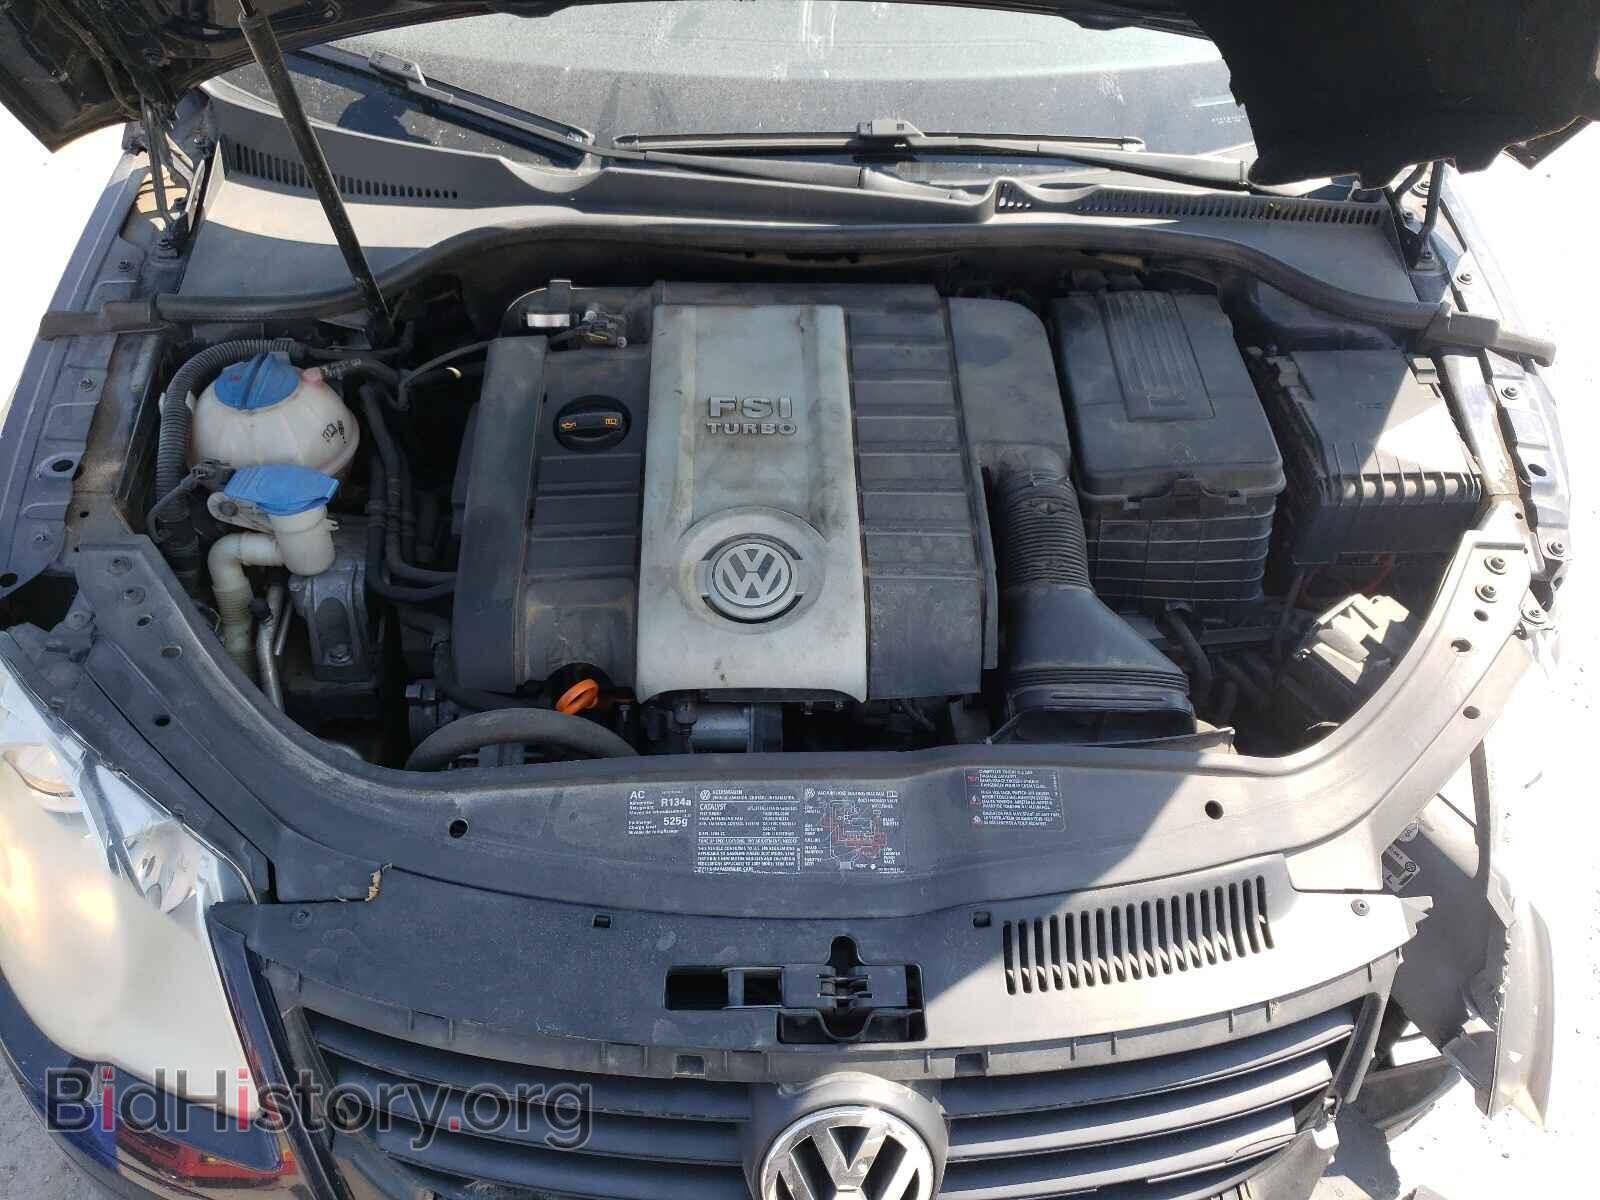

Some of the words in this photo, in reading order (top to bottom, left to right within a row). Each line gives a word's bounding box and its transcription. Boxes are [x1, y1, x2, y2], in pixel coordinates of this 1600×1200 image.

[708, 396, 793, 418] FSI
[707, 423, 797, 435] TURBO
[712, 543, 792, 608] VW
[630, 790, 645, 800] AC
[661, 797, 692, 807] R134a
[699, 803, 727, 811] CATALYST
[663, 816, 688, 827] 525g
